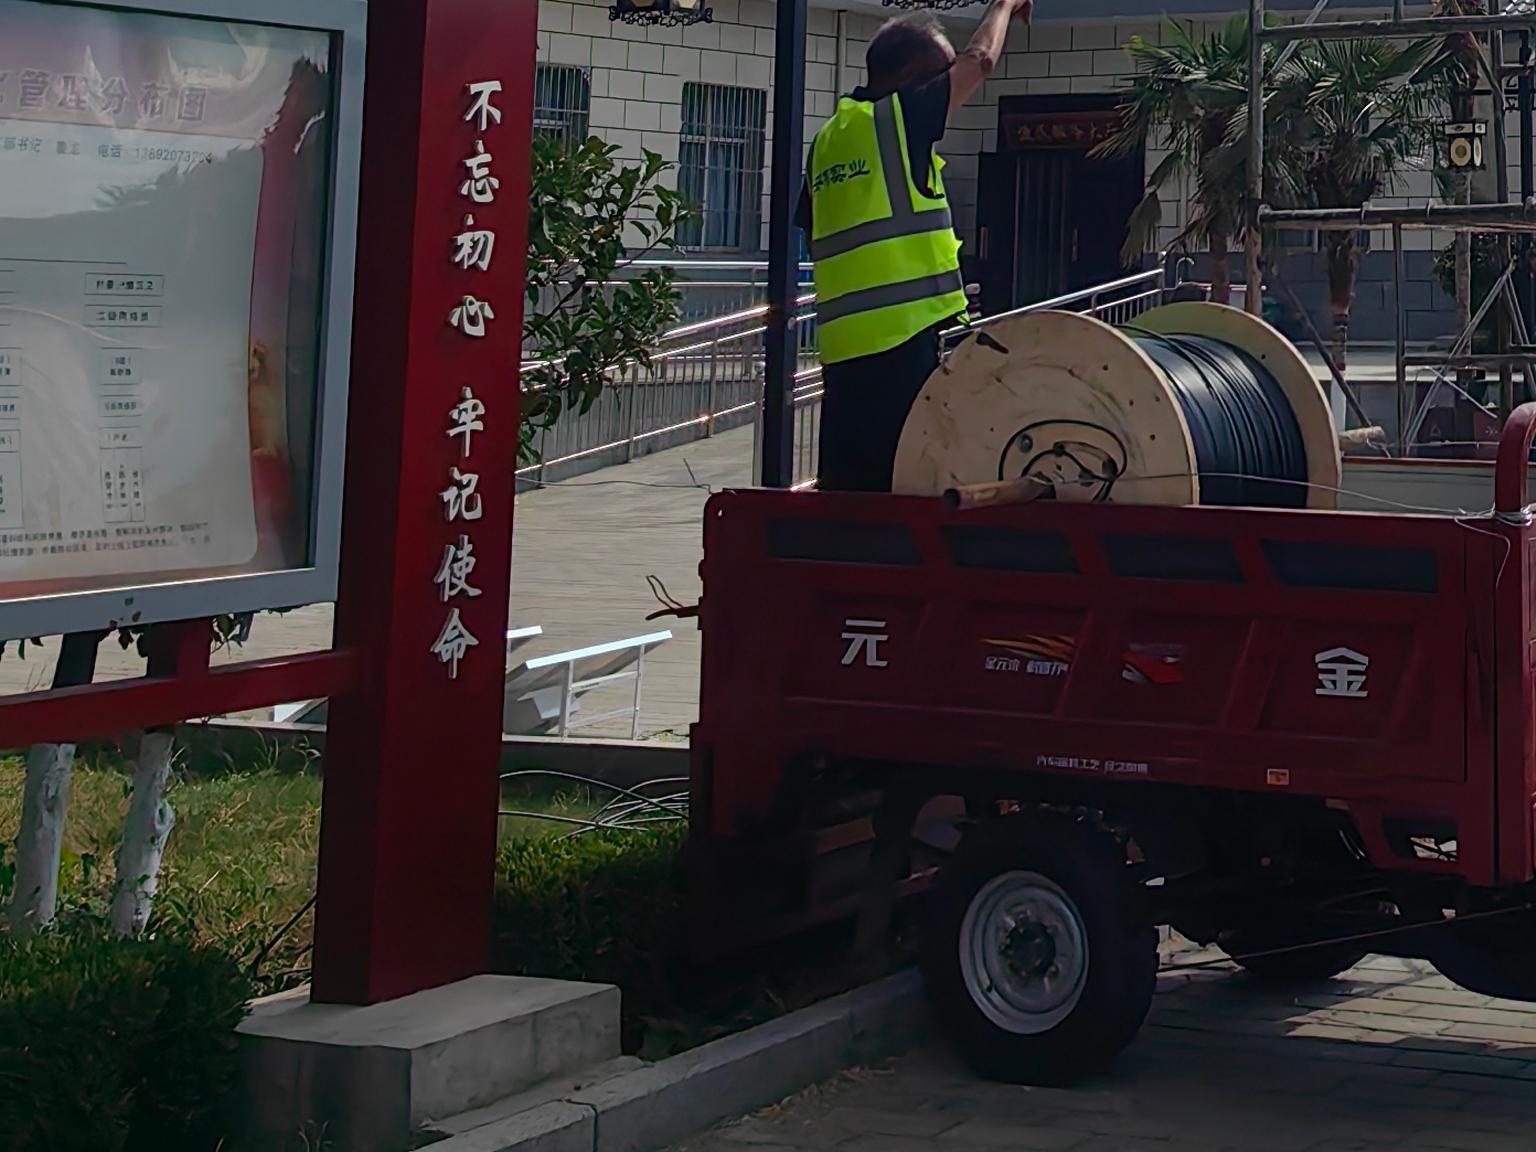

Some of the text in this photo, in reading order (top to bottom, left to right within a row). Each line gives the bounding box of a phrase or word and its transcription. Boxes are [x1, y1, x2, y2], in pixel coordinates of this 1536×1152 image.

[0, 69, 208, 121] 管理分布图
[431, 81, 502, 679] 不忘初心 牢记使命
[841, 619, 889, 667] 元
[1315, 647, 1369, 698] 金
